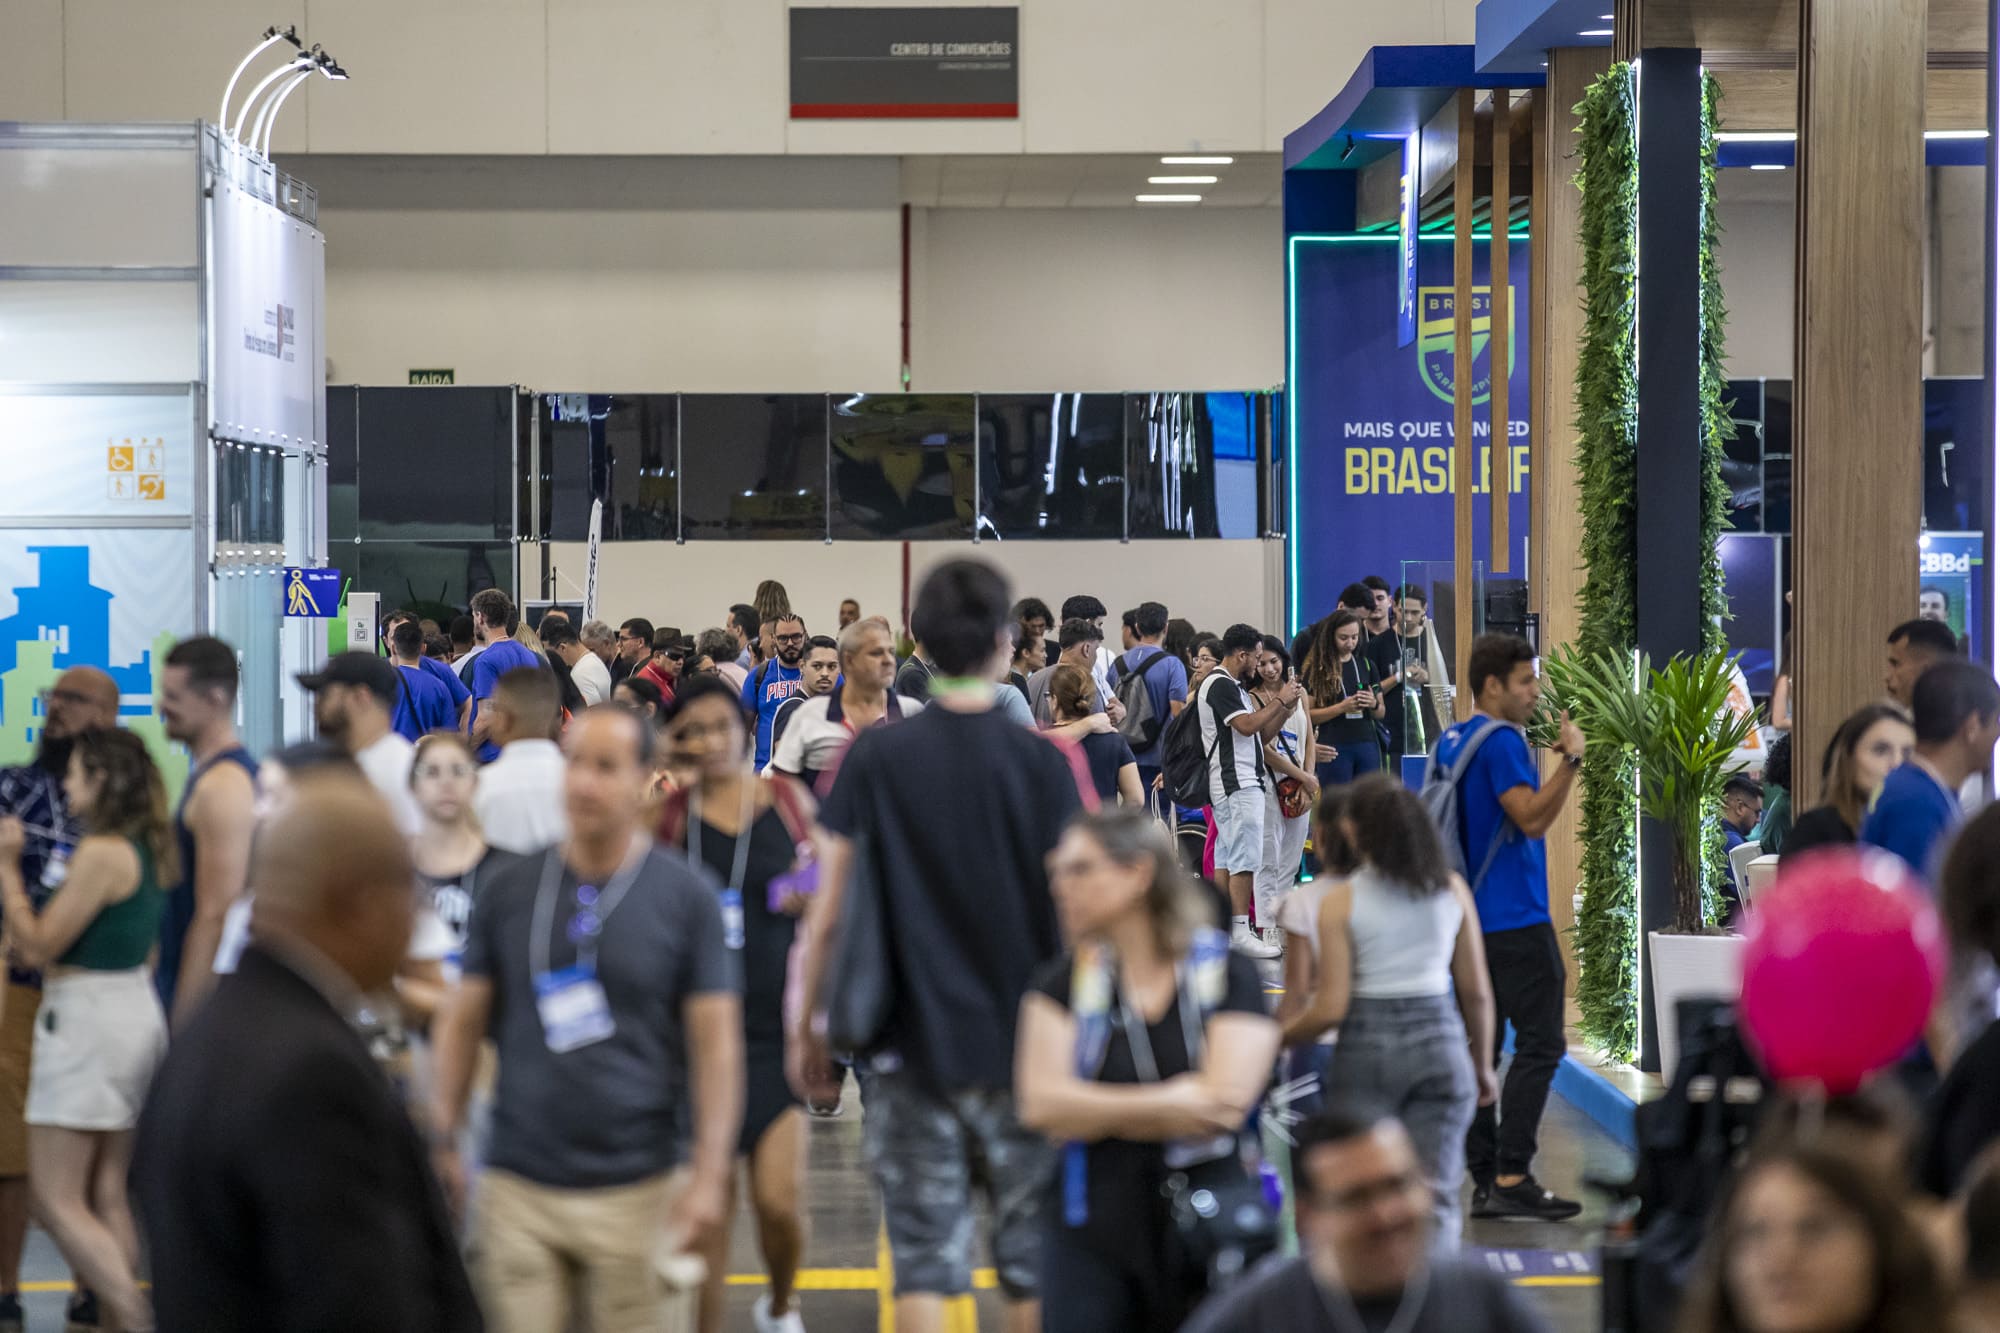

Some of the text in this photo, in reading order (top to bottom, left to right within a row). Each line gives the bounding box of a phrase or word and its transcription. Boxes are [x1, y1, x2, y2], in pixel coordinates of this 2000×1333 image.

[890, 40, 1012, 58] CENTRO DE CONVENÇÕES
[1344, 422, 1394, 438] MAIS
[1400, 422, 1442, 441] QUE
